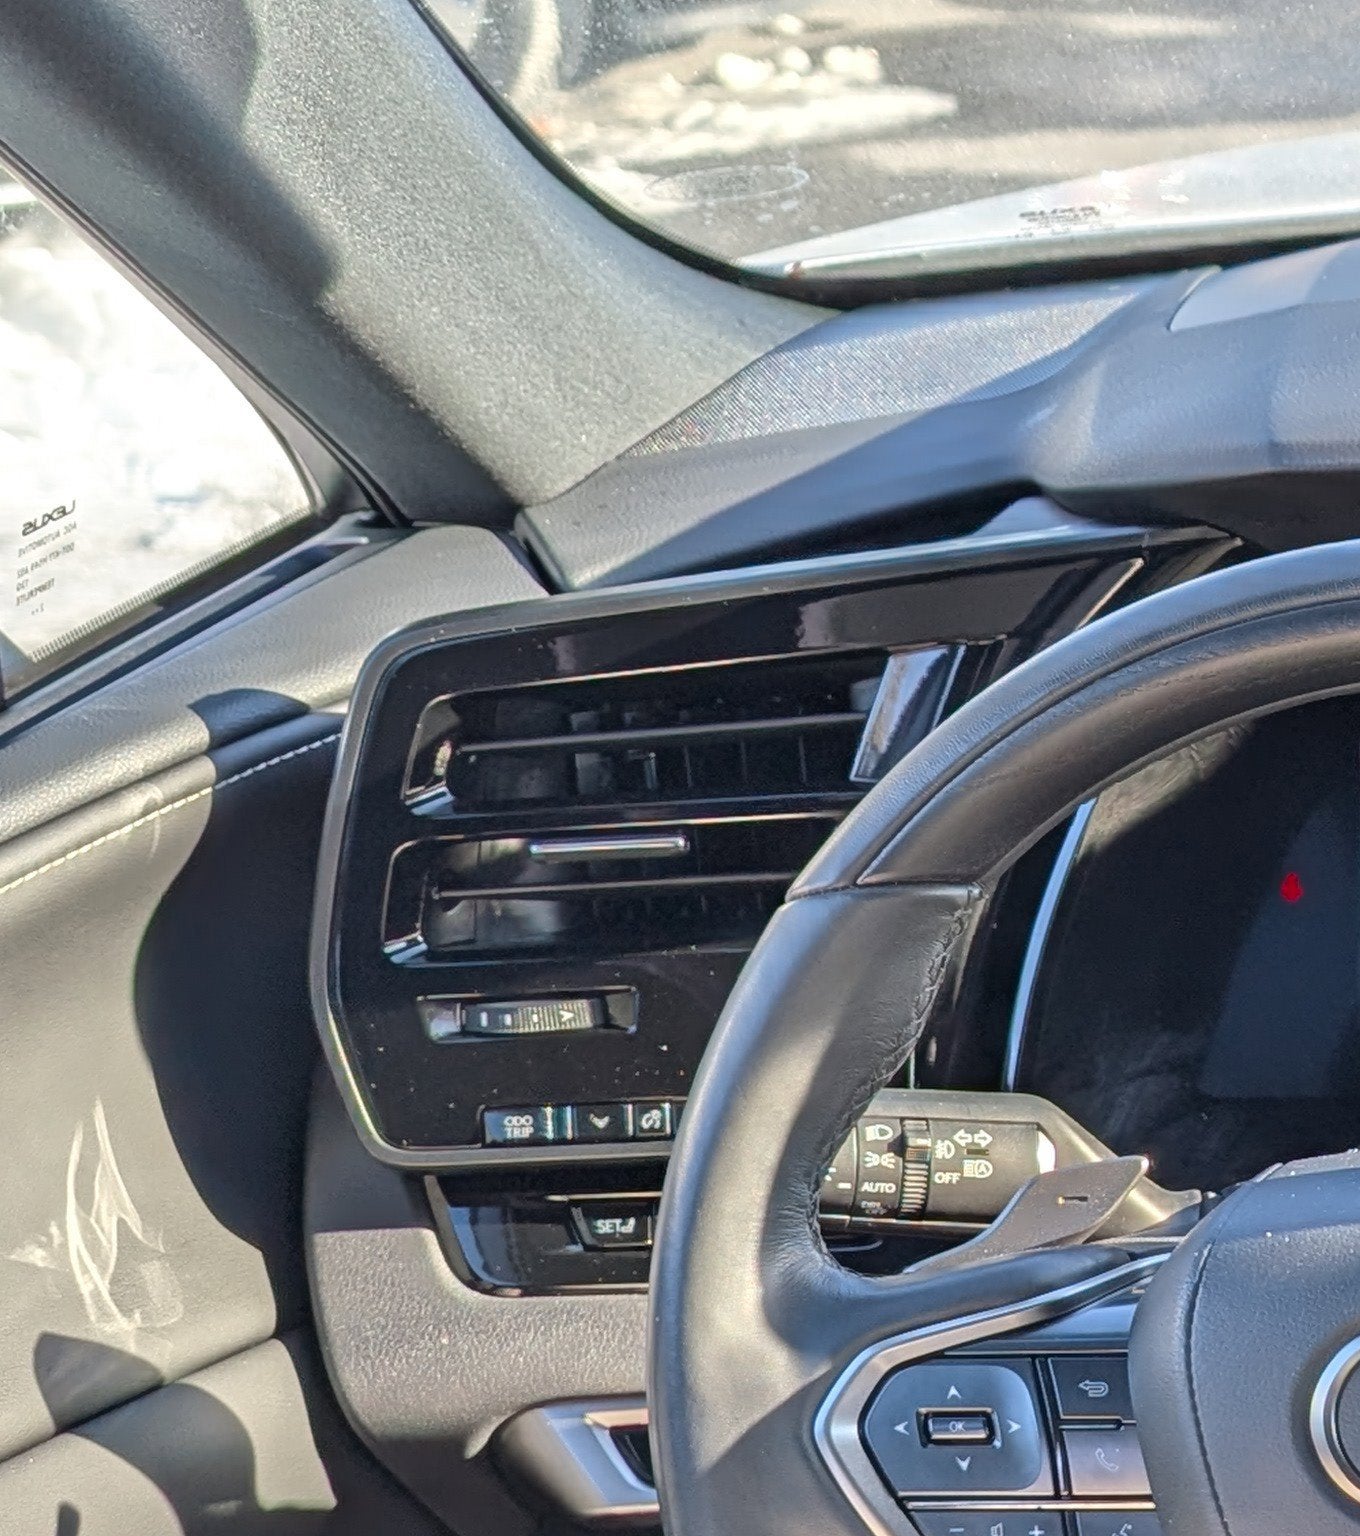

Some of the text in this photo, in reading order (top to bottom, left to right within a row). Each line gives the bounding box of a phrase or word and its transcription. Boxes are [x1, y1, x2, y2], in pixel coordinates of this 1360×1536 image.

[503, 1114, 534, 1126] ODO
[504, 1126, 535, 1139] TRIP
[933, 1171, 962, 1185] OFF
[860, 1181, 897, 1194] AUTO
[596, 1218, 622, 1234] SET
[949, 1420, 966, 1434] OK
